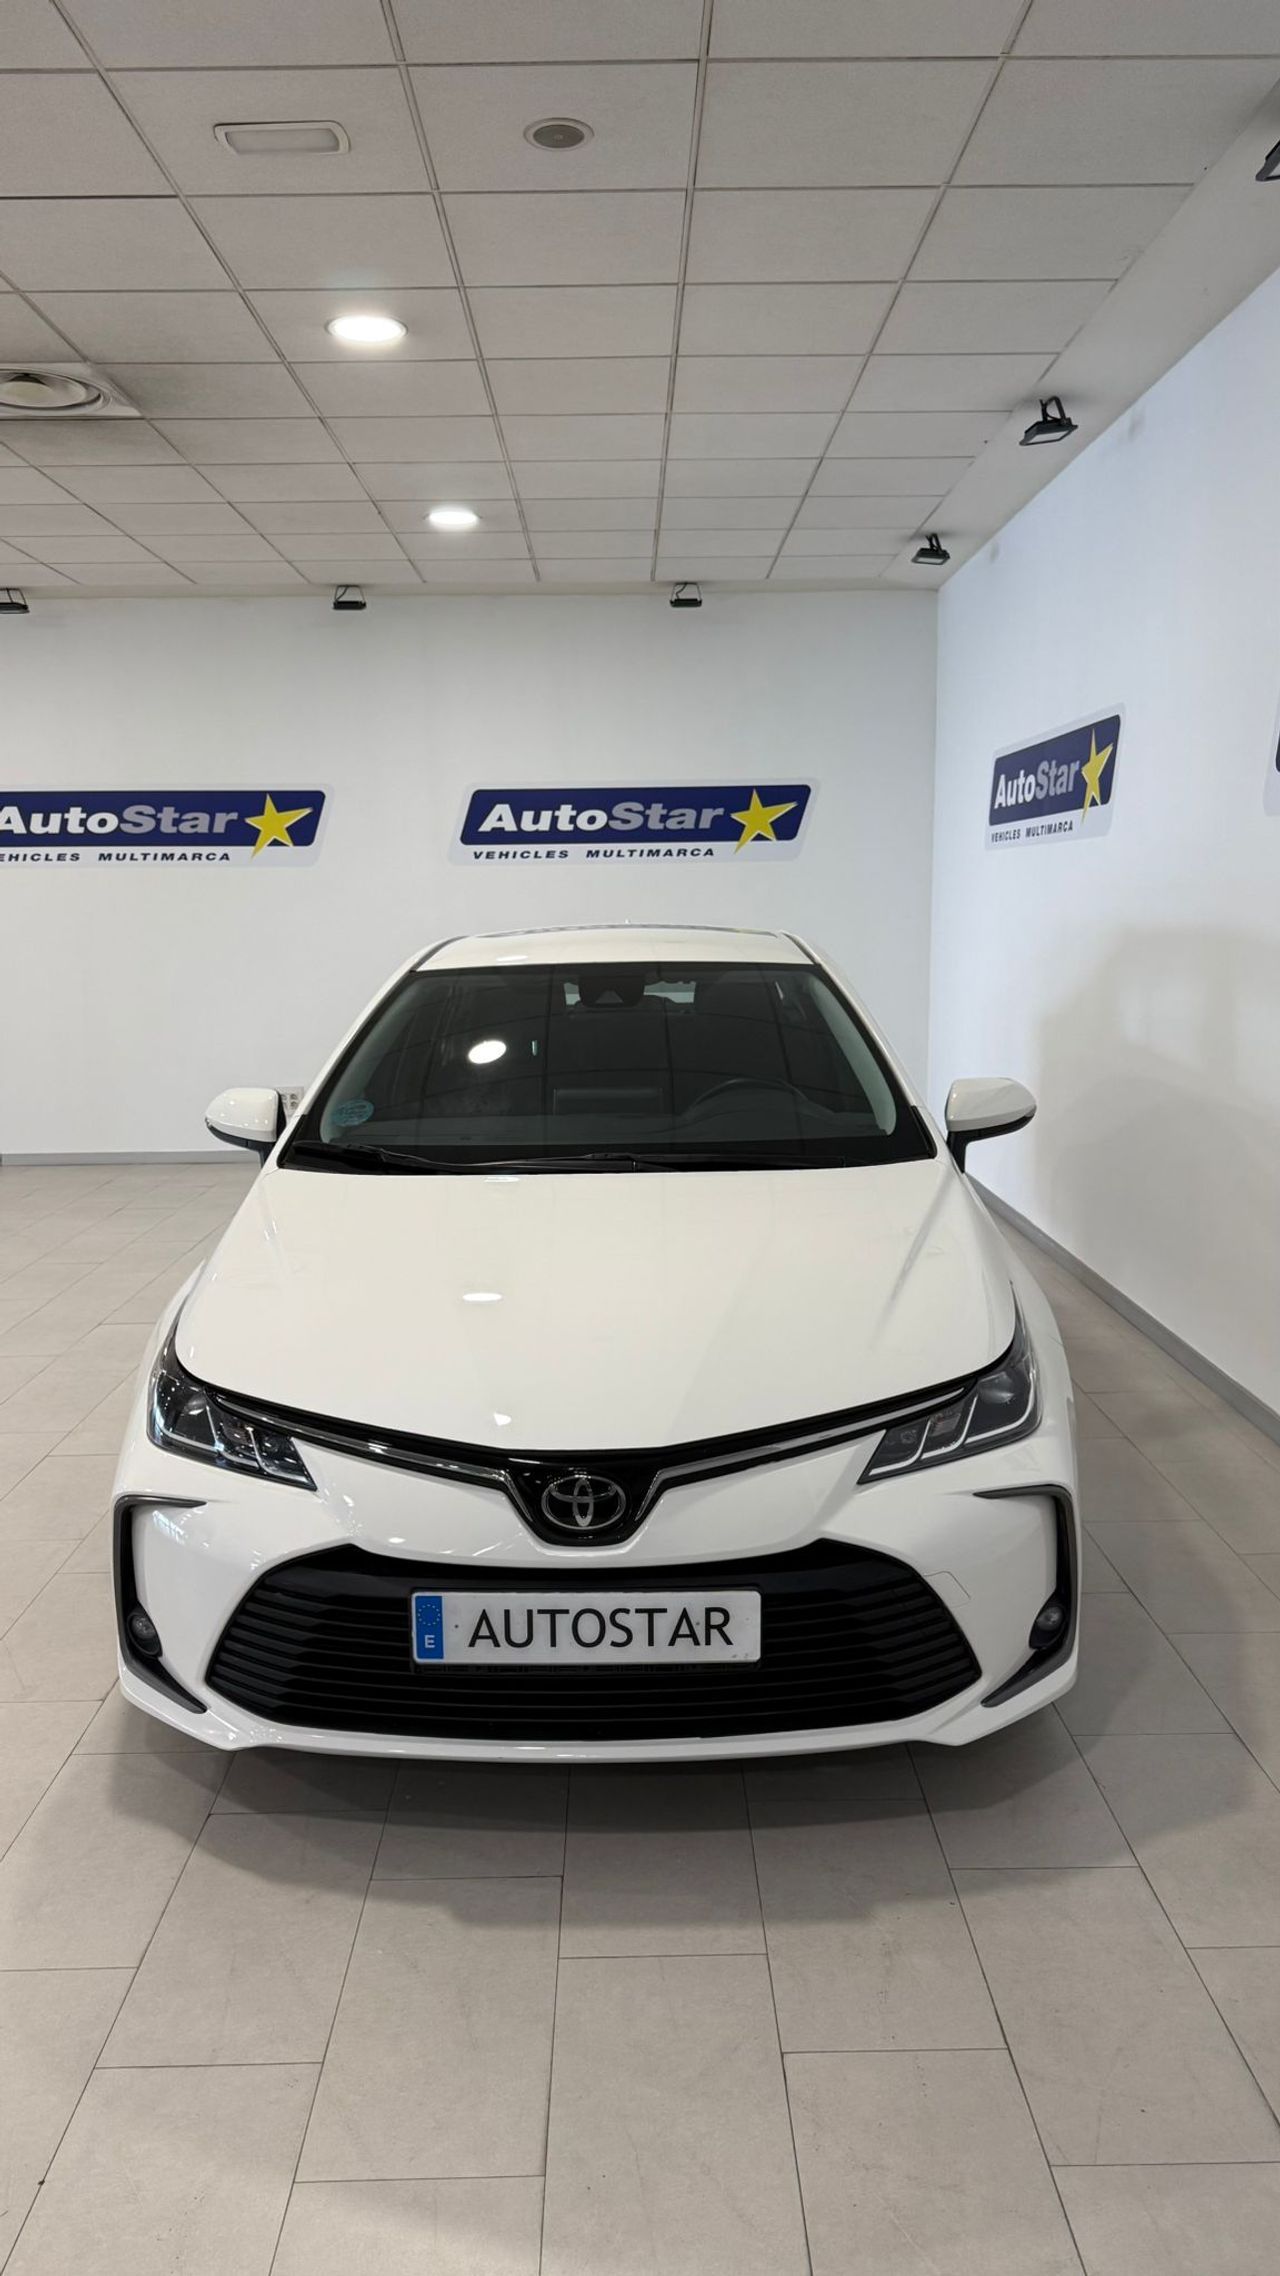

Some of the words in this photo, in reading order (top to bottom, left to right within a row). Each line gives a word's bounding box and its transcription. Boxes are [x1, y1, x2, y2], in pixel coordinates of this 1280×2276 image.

[993, 760, 1081, 810] AutoStar
[0, 804, 239, 835] AutoStar
[478, 801, 725, 832] AutoStar
[991, 828, 1021, 843] VEHICLES
[1025, 820, 1074, 838] MULTIMARCA
[0, 852, 81, 862] EHICLES
[98, 852, 231, 862] MULTIMARCA
[473, 849, 569, 860] VEHICLES
[586, 847, 715, 858] MULTIMARCA
[424, 1634, 436, 1649] E
[467, 1606, 734, 1649] AUTOSTAR
